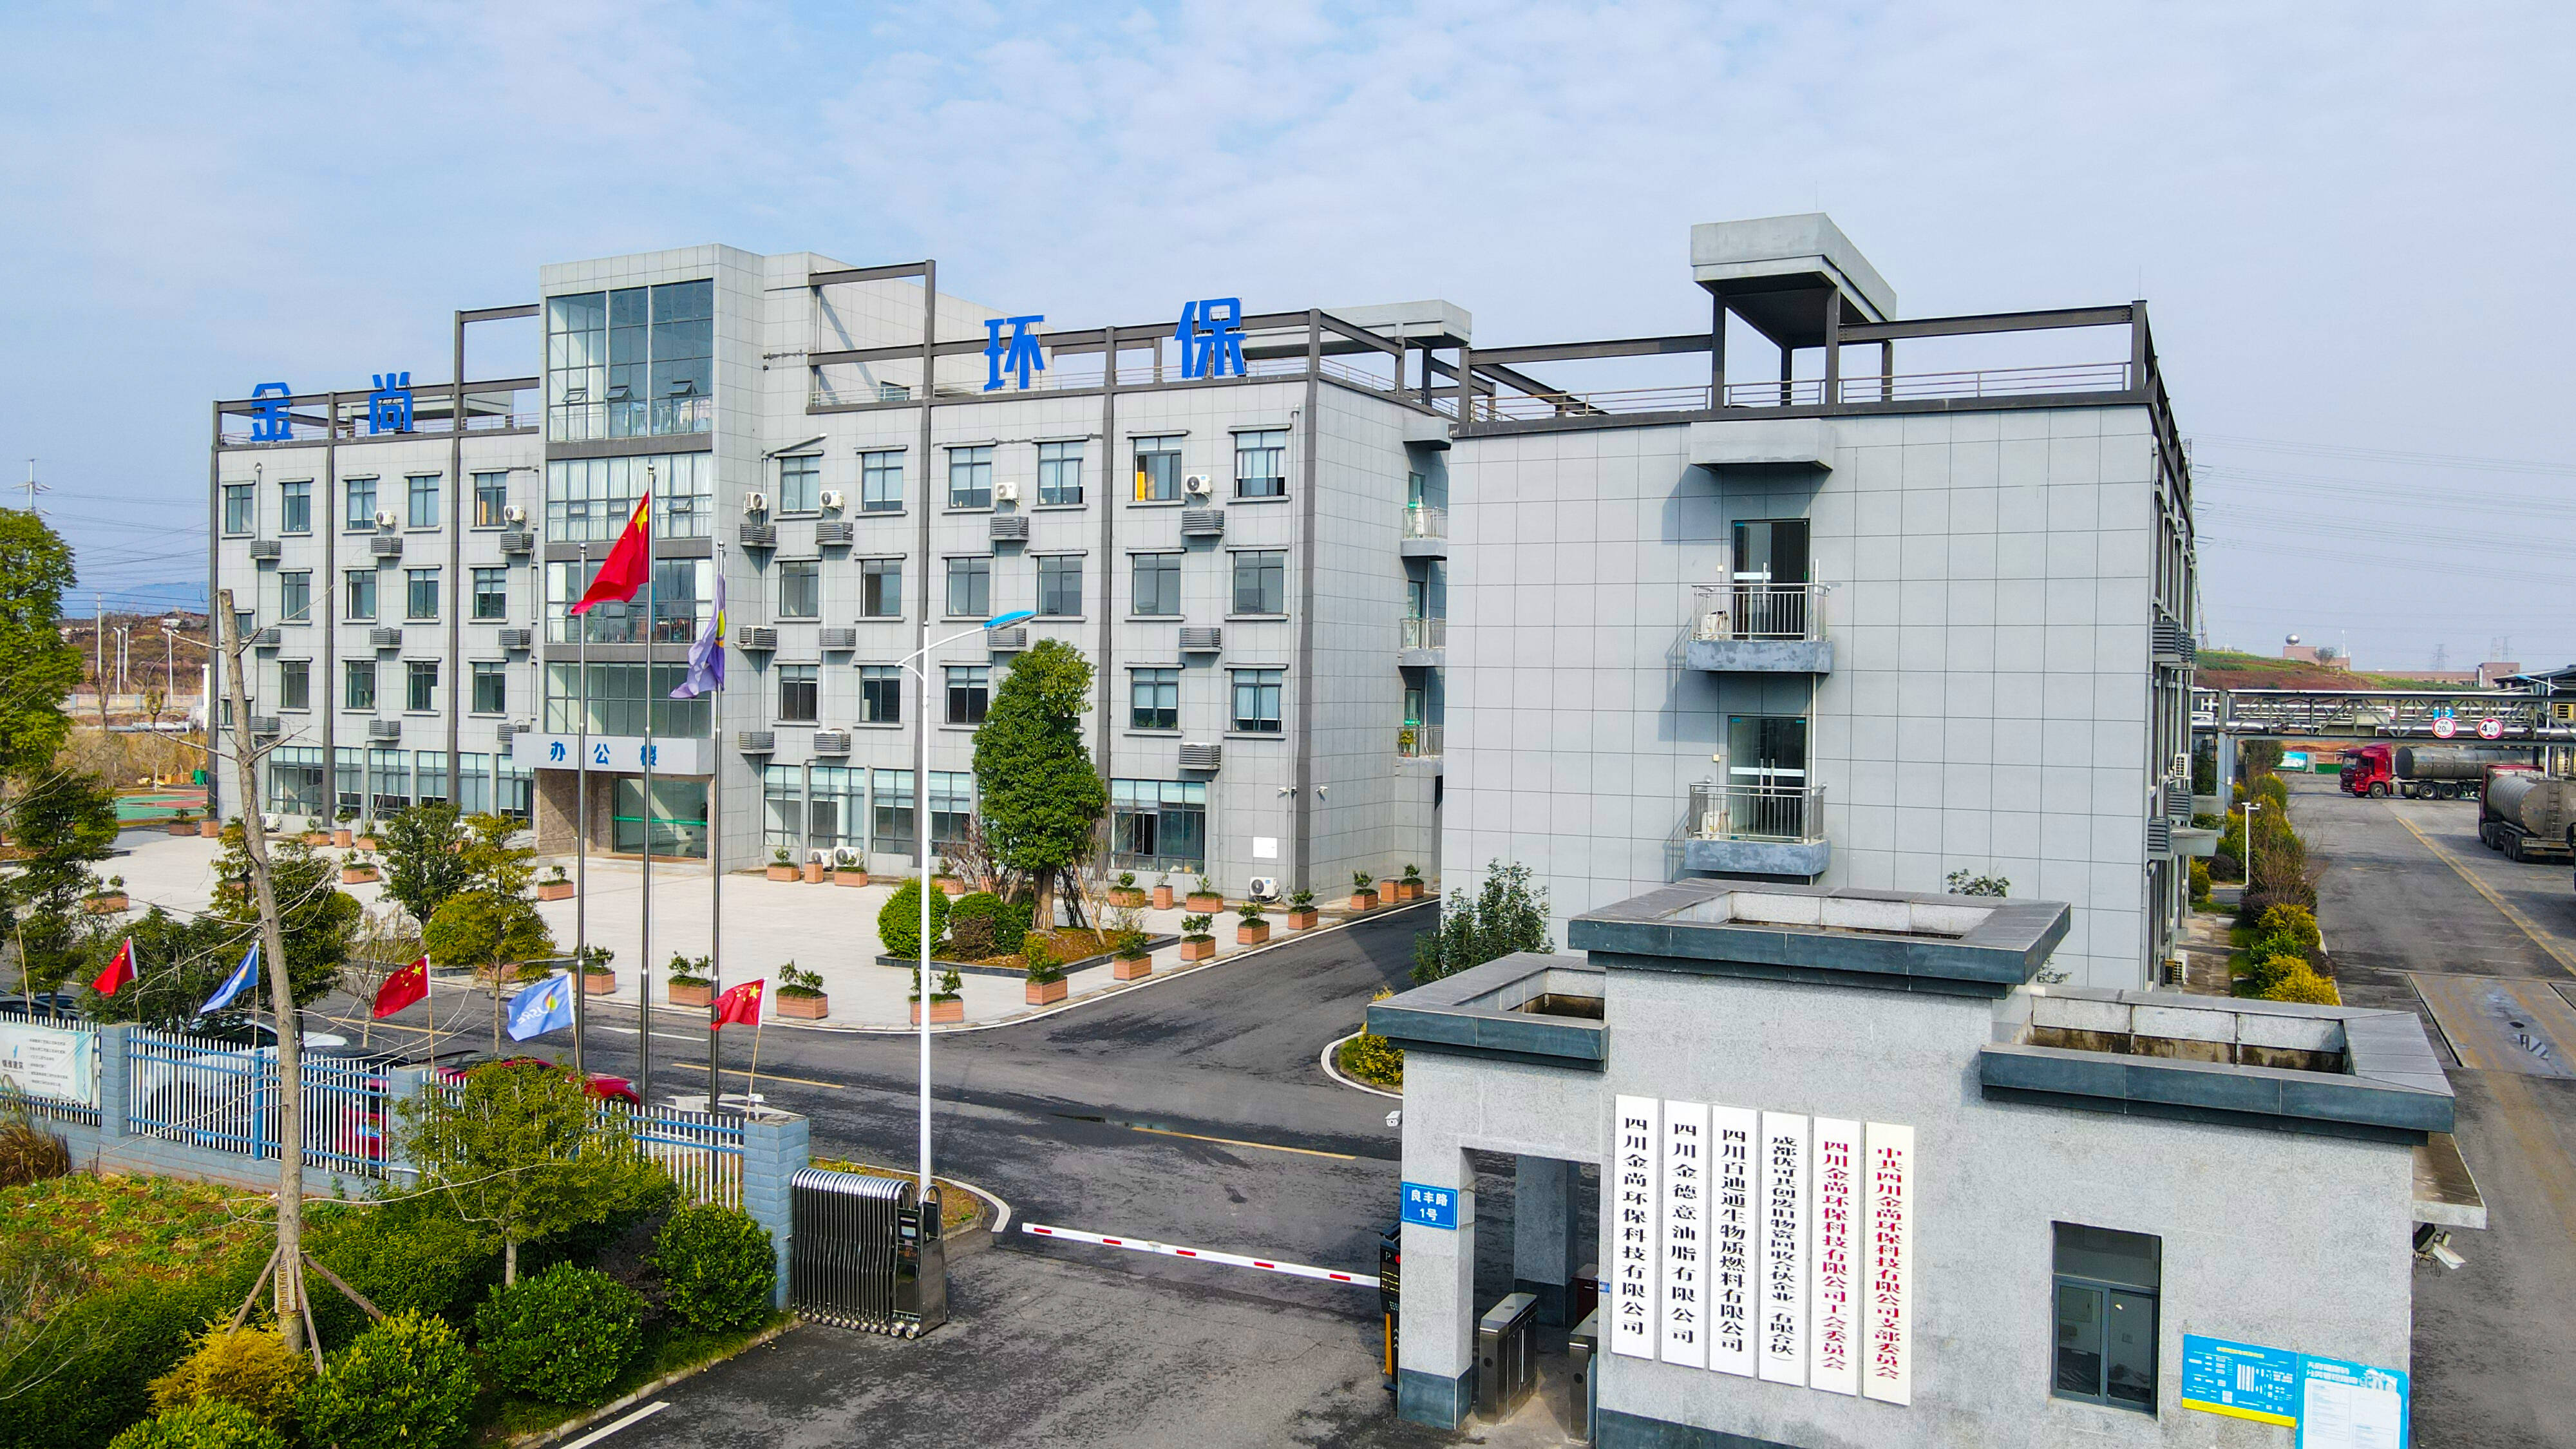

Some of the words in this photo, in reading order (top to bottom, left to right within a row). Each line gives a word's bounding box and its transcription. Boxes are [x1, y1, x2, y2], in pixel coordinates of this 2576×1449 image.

[251, 372, 413, 442] 金尚
[983, 297, 1246, 392] 环保
[550, 741, 657, 766] 办公楼
[1385, 1251, 1391, 1260] P
[1411, 1189, 1448, 1207] 良丰路
[1419, 1208, 1438, 1221] 1号
[1622, 1117, 1647, 1336] 四川金尚环保科技有限公司
[1671, 1123, 1698, 1344] 四川金德意油脂有限公司
[1719, 1129, 1747, 1353] 四川百迪通生物质燃料有限公司
[1821, 1141, 1850, 1370] 四川金尚环保科技有限公司工会委员会
[1874, 1147, 1903, 1380] 中共四川金尚环保科技有限公司支部委员会
